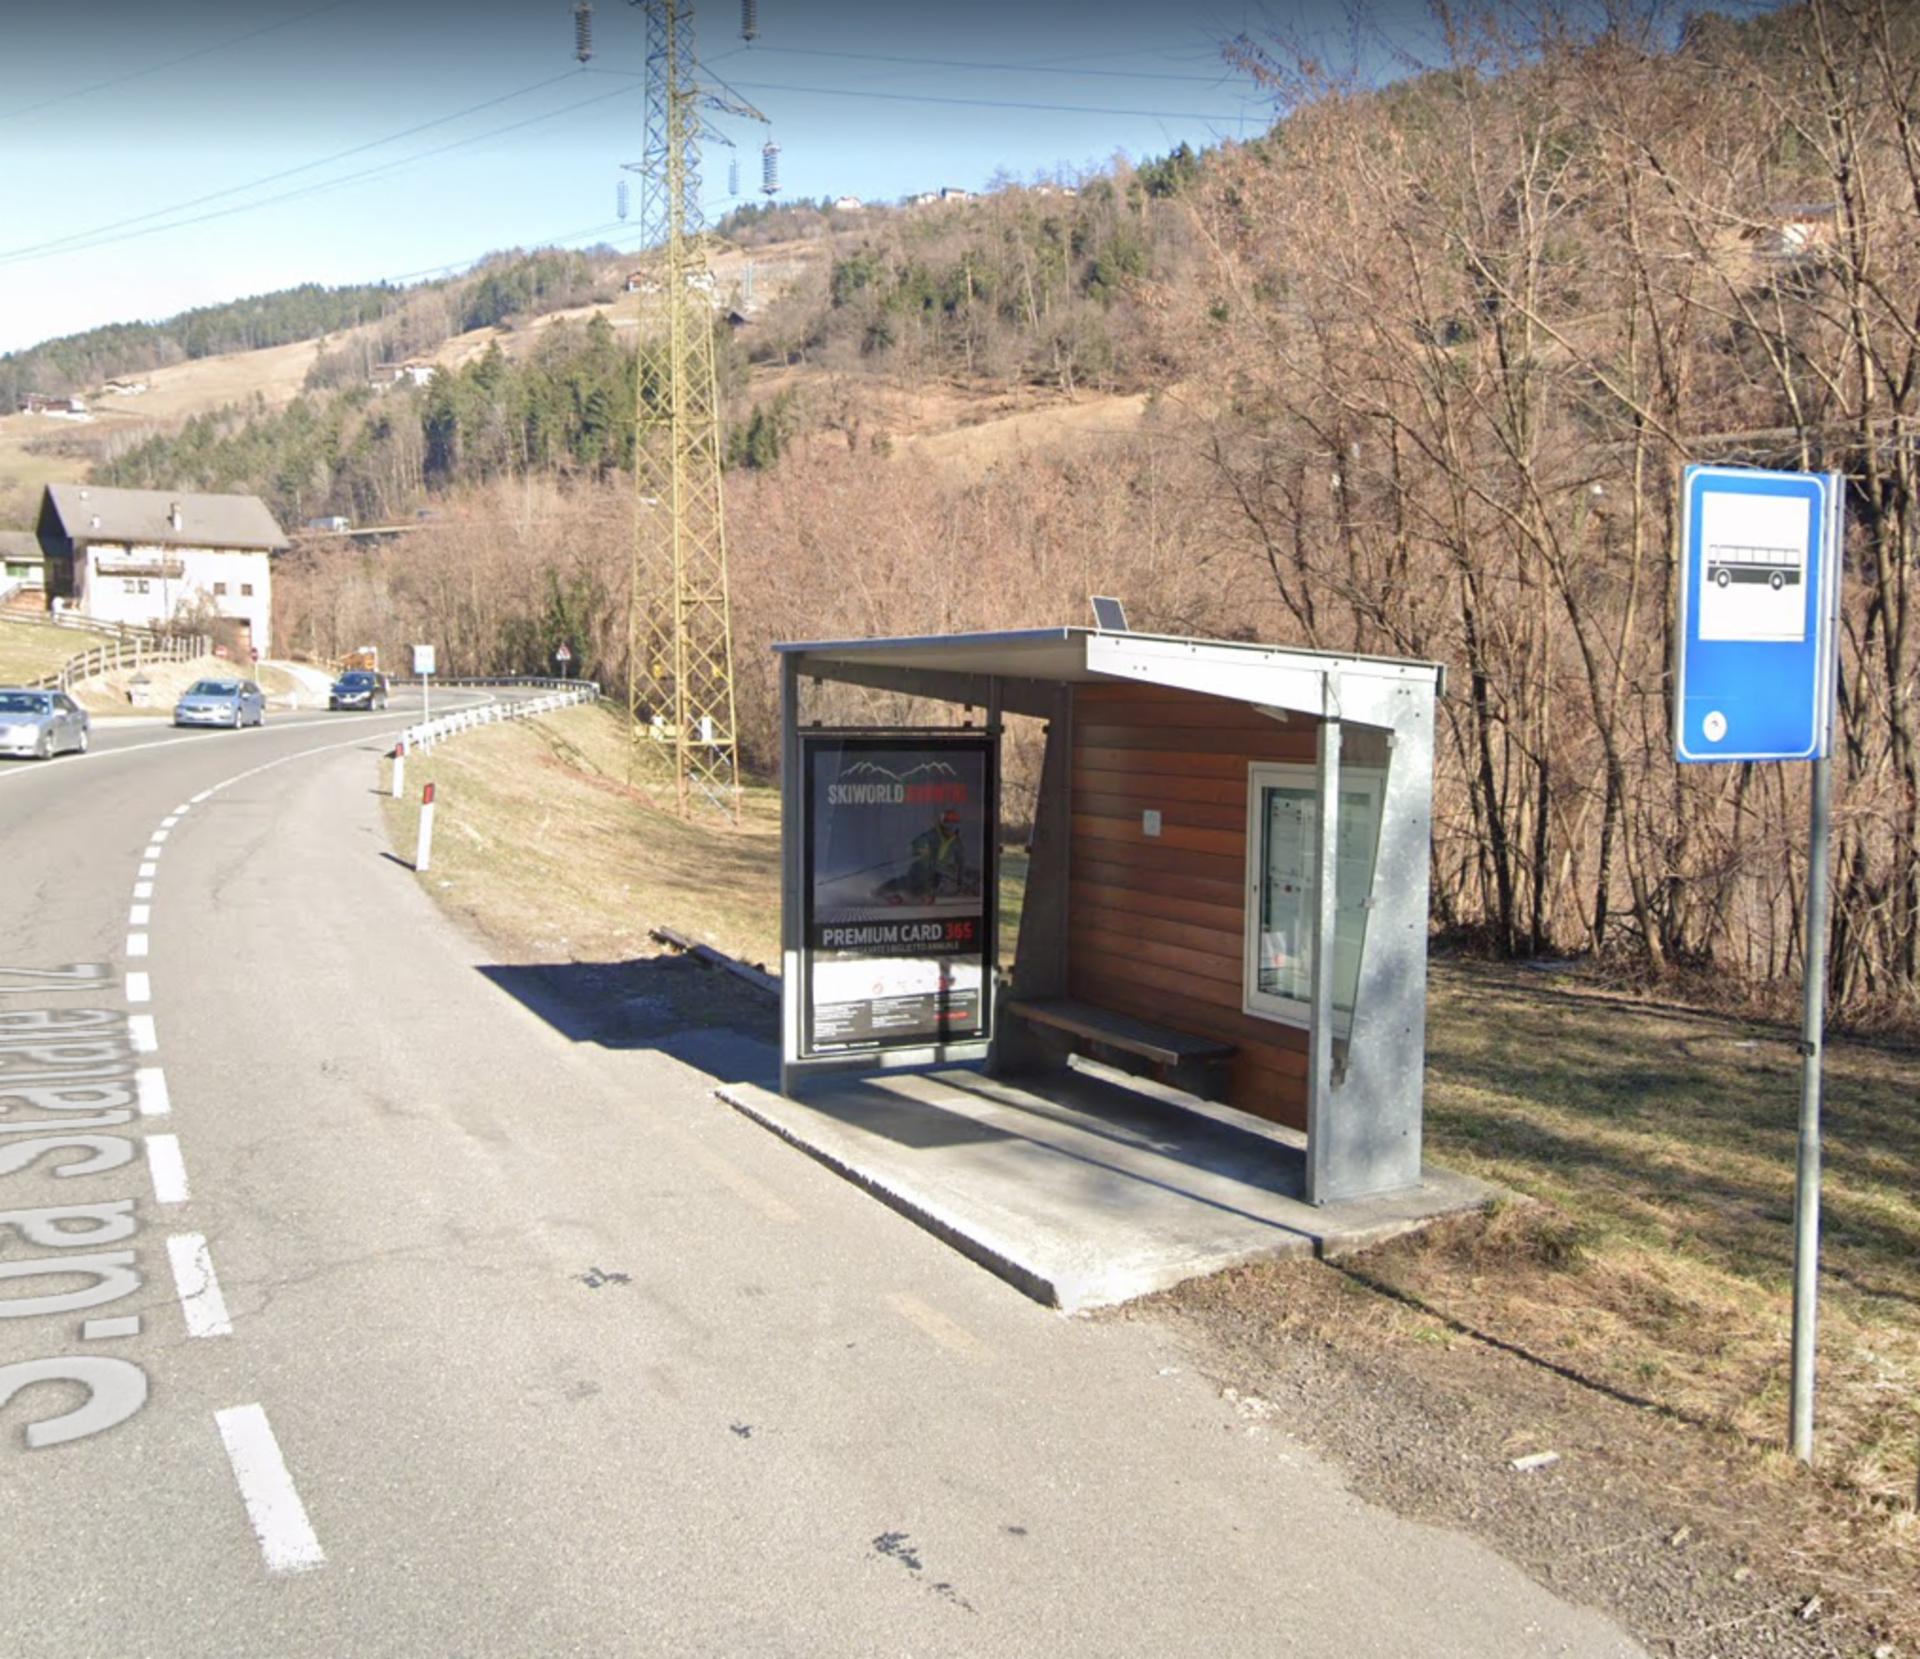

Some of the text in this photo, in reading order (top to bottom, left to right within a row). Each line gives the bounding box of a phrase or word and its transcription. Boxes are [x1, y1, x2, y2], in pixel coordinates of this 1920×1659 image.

[828, 783, 904, 805] SKIWORLD
[822, 921, 974, 946] PREMIUM CARD 365
